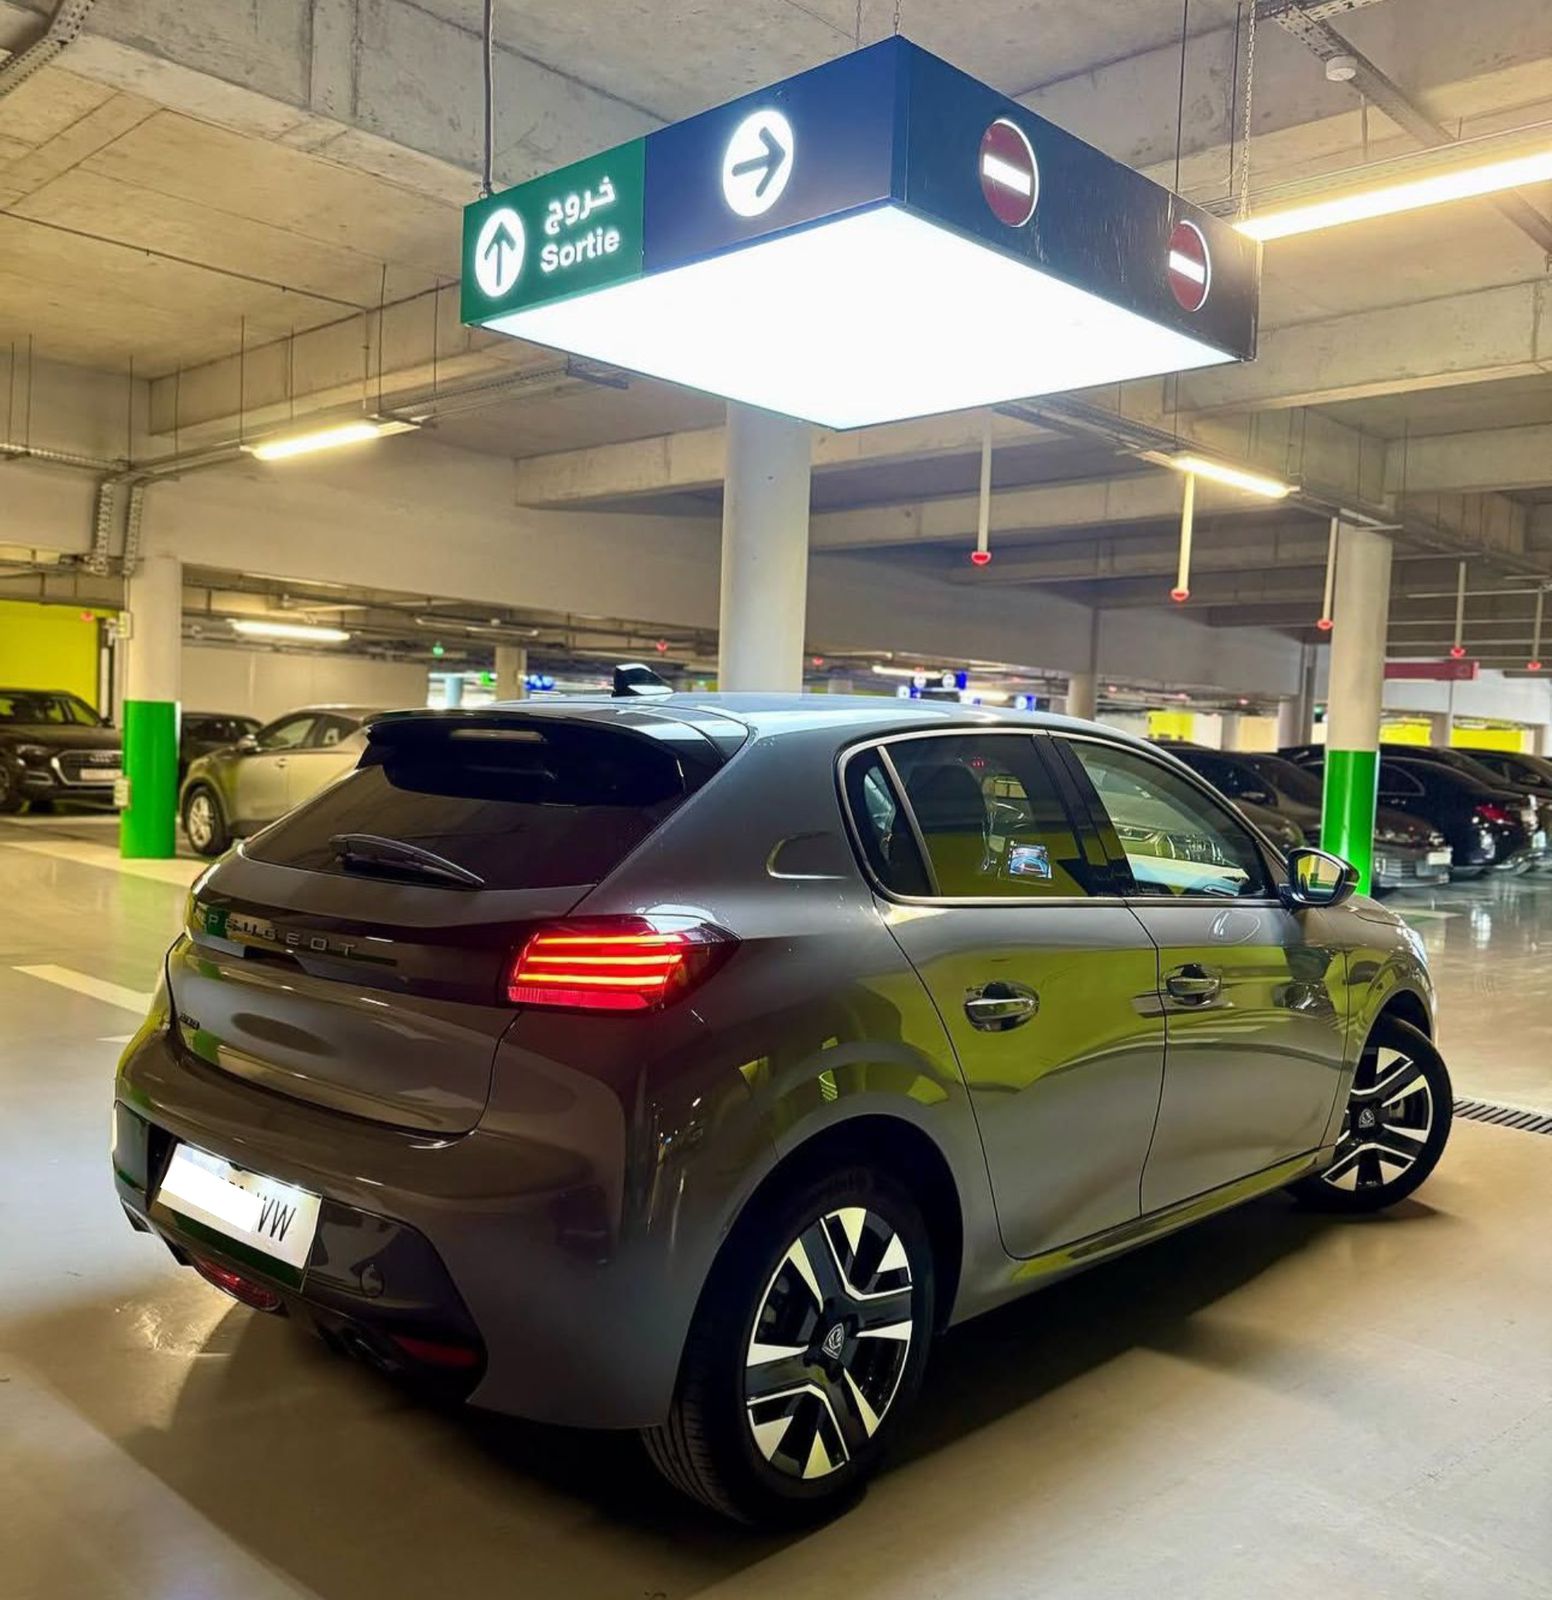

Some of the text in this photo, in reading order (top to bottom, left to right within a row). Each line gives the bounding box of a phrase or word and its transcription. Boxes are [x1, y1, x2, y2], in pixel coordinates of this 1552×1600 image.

[544, 176, 616, 235] خروج
[540, 228, 620, 273] Sortie
[208, 913, 356, 957] PEUGEOT
